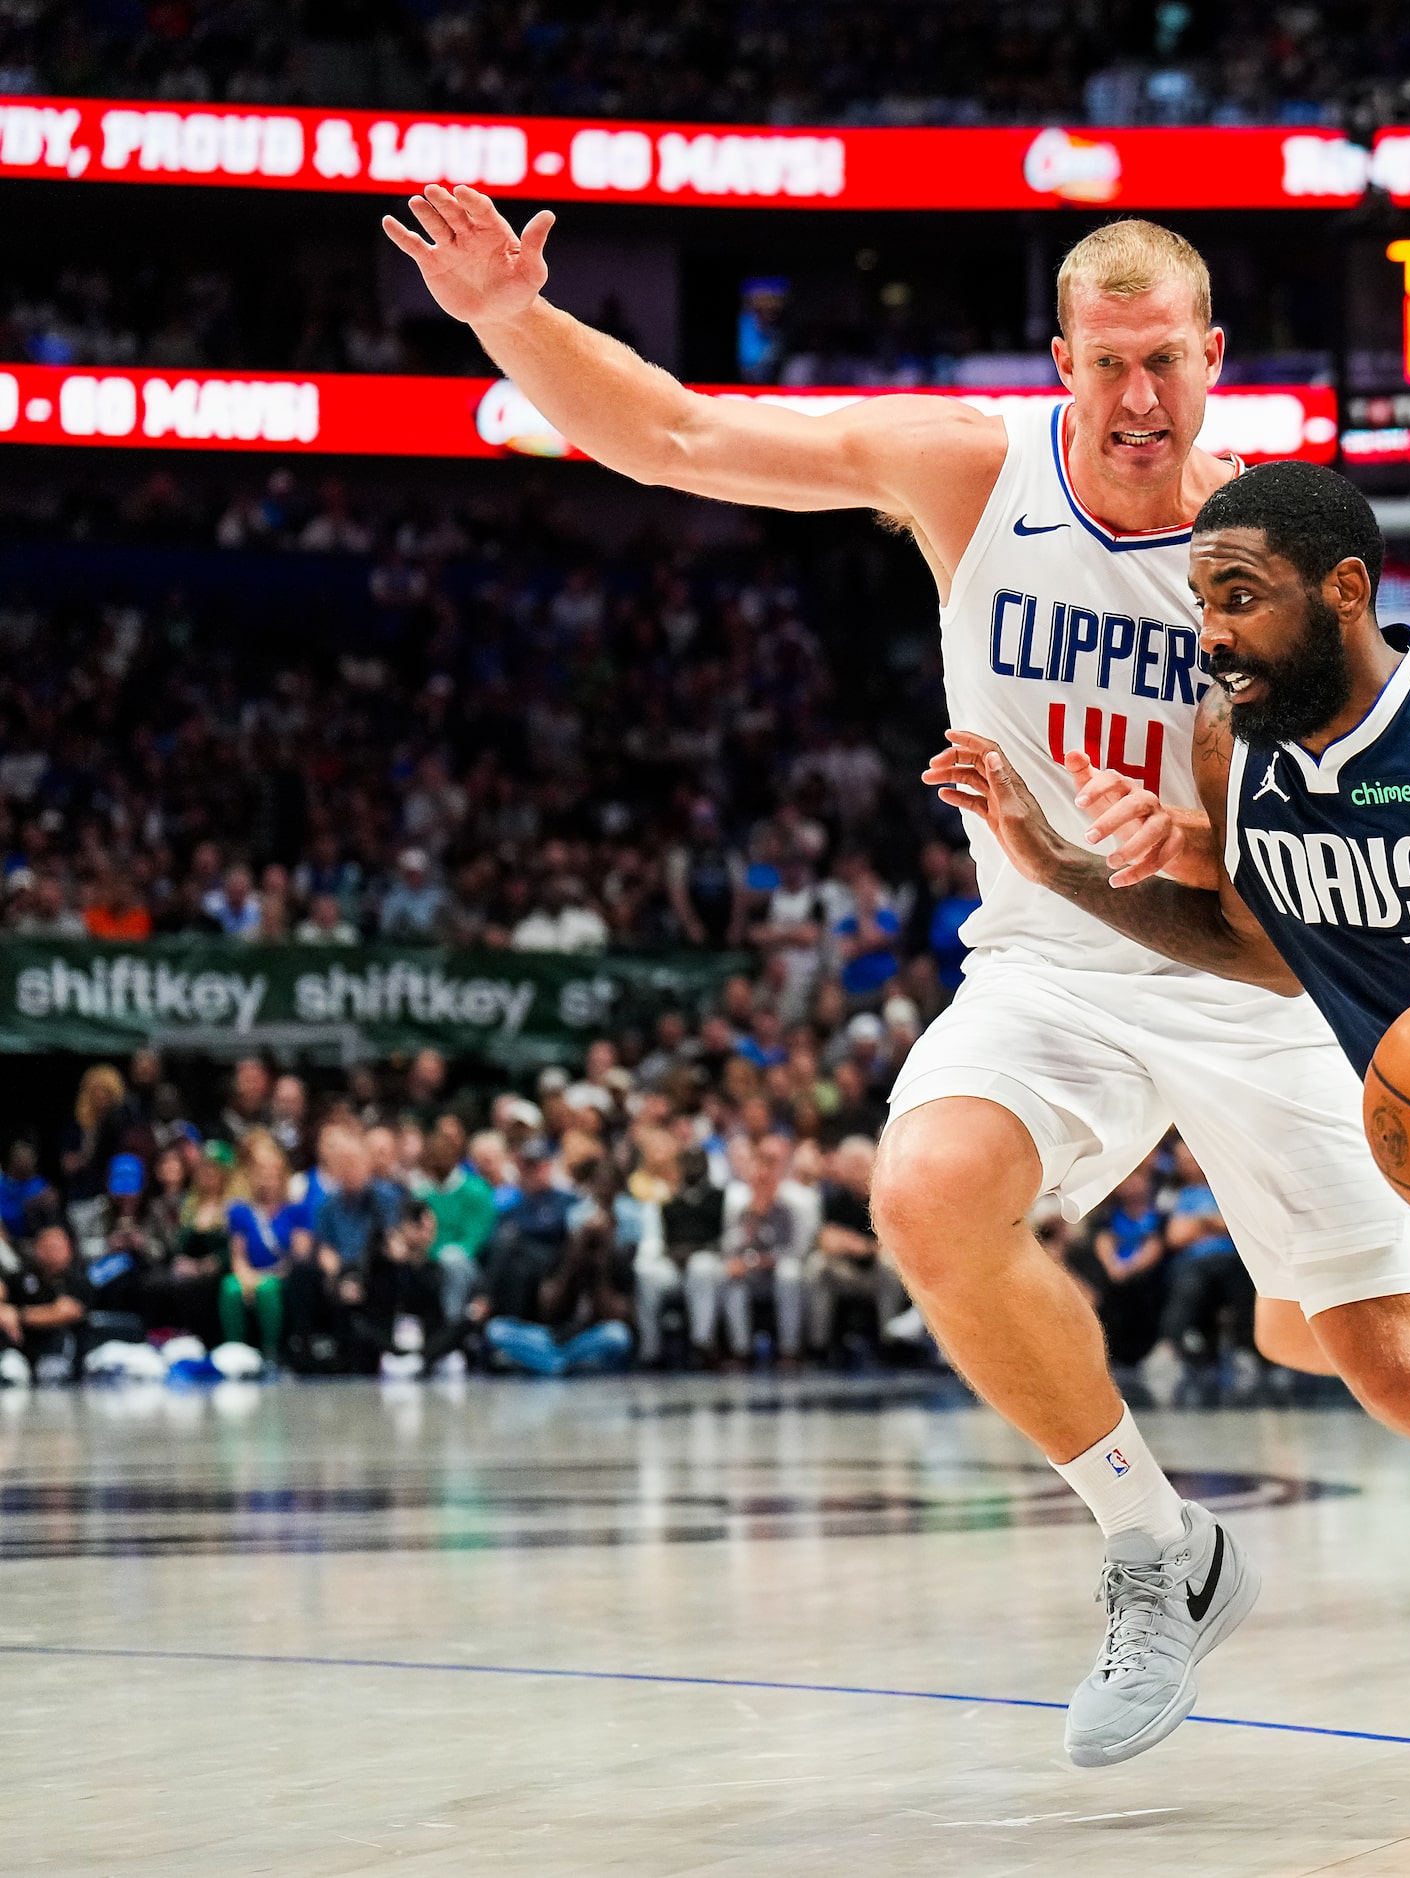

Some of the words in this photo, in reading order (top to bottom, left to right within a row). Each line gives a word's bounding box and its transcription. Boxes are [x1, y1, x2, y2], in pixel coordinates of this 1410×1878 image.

[0, 105, 91, 178] DY,
[101, 110, 304, 176] PROUD
[313, 119, 360, 178] &
[369, 122, 527, 185] LOUD
[658, 133, 845, 196] MAVS!
[142, 377, 319, 443] MAVS!
[1047, 702, 1164, 799] 44
[16, 957, 265, 1036] shiftkey
[294, 961, 535, 1040] shiftkey
